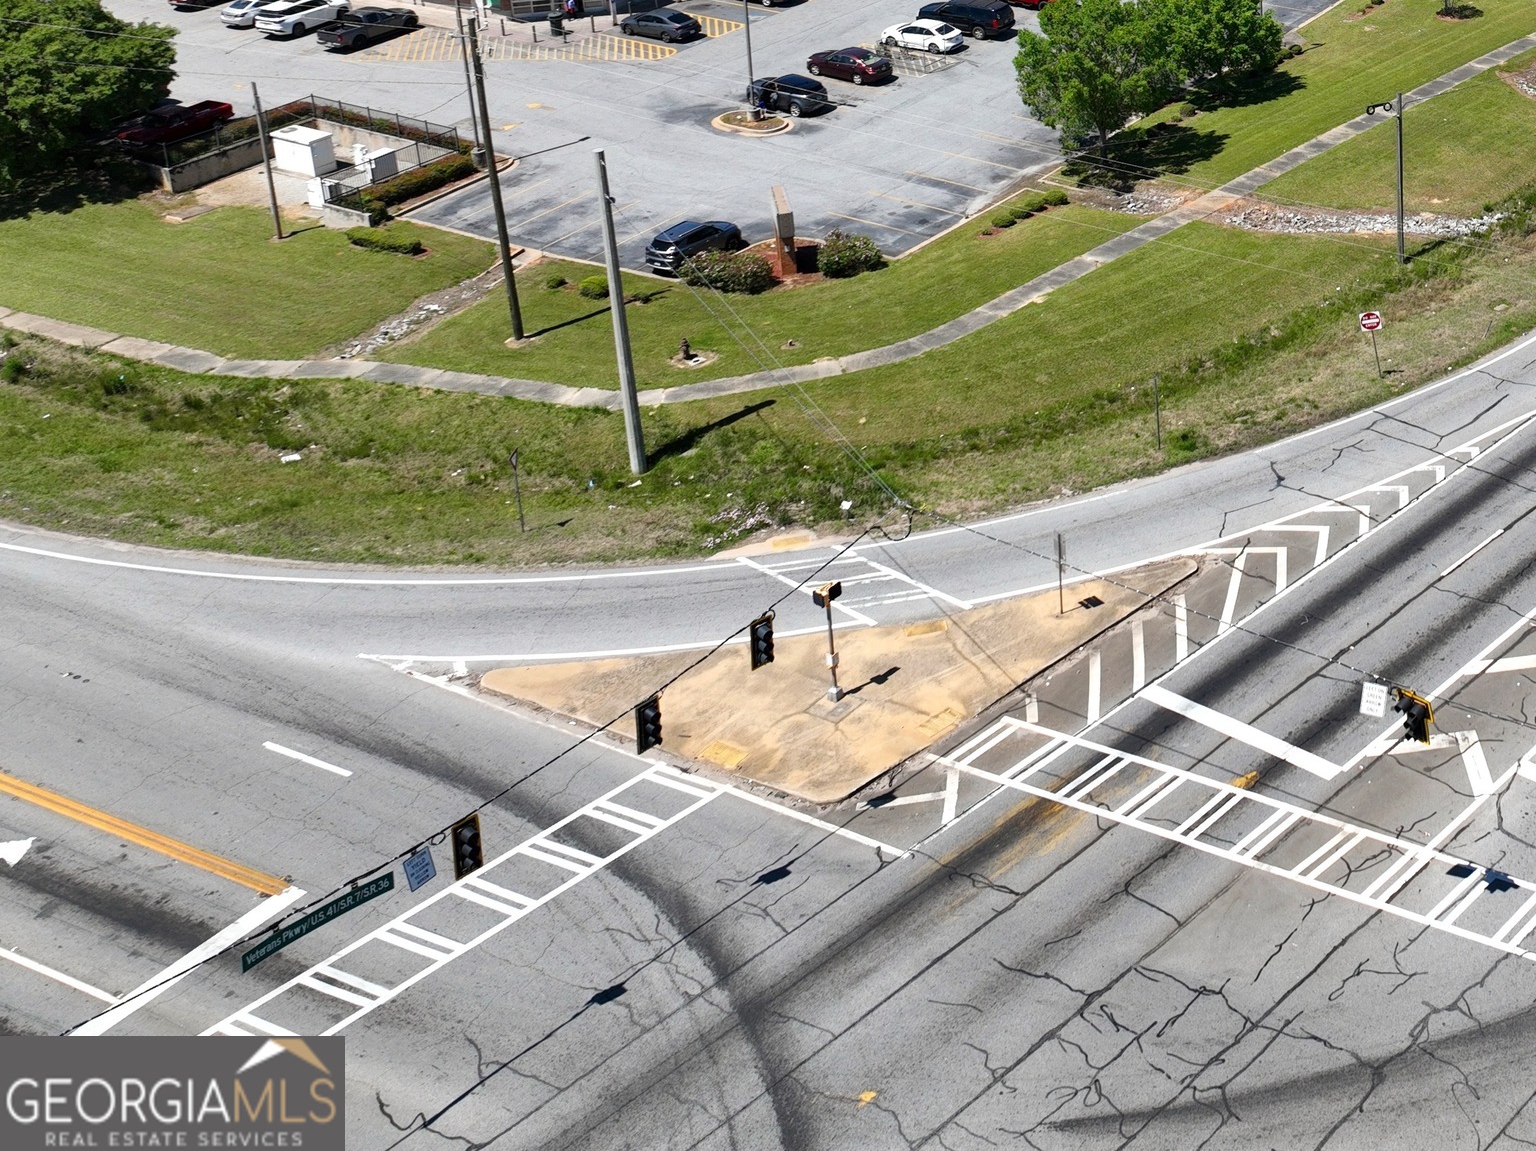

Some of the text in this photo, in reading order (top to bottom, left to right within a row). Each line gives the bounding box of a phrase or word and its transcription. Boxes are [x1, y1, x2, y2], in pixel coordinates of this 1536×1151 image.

[411, 857, 426, 870] YIELD
[246, 937, 283, 965] Veterans
[378, 878, 390, 890] 36
